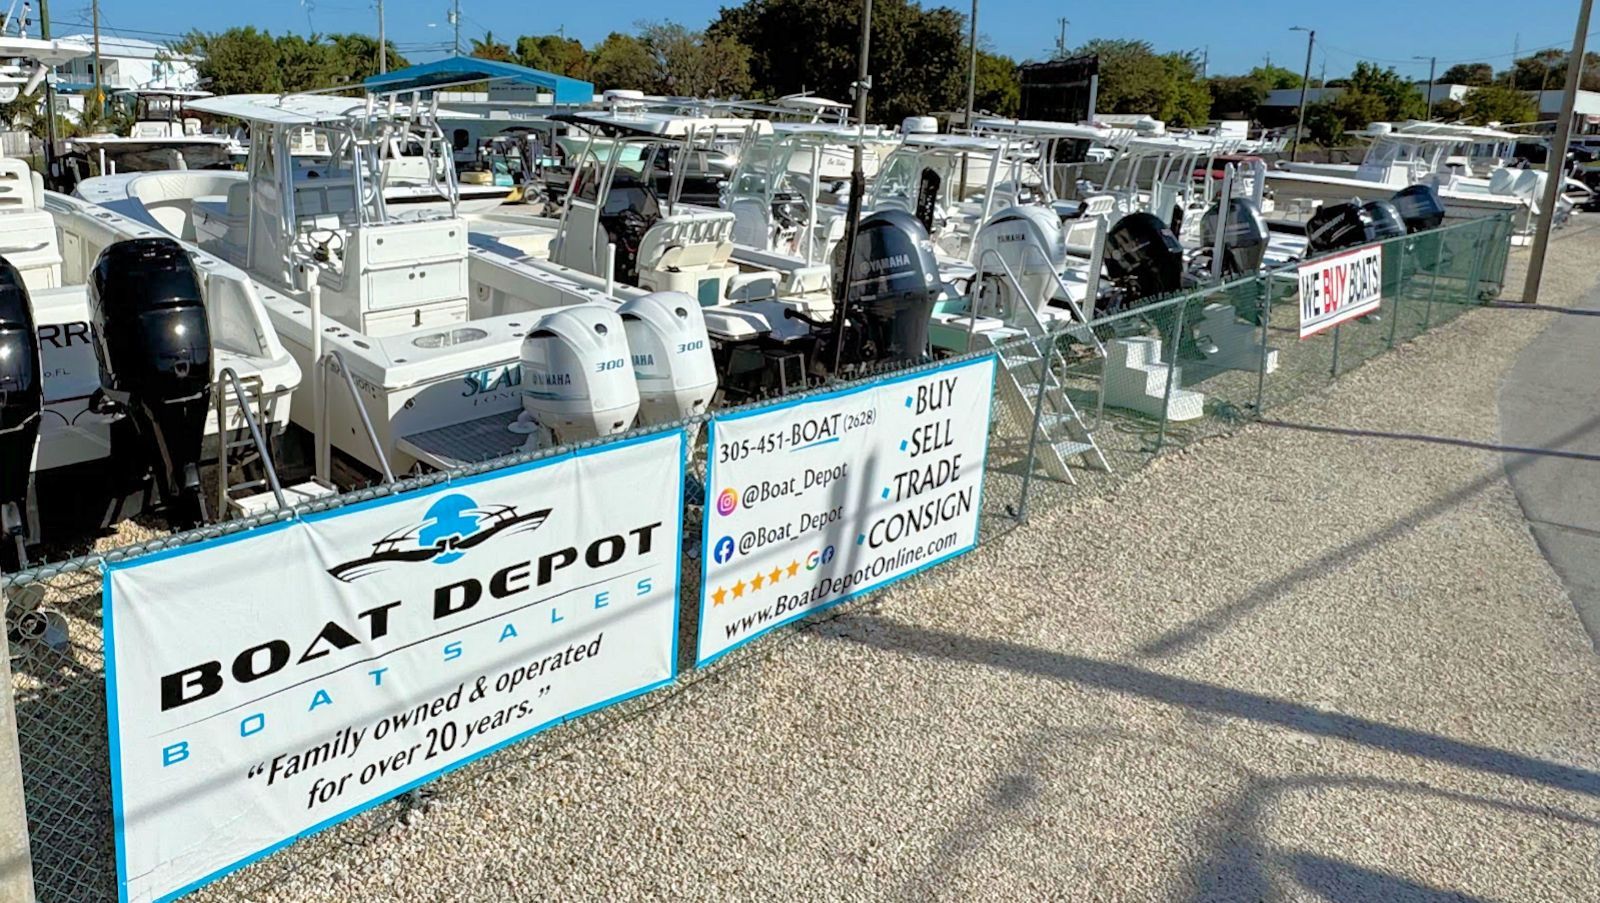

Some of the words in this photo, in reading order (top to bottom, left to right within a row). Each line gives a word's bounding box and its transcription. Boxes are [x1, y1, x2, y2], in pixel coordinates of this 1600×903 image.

[870, 254, 910, 272] YAMAHA
[1302, 272, 1320, 319] WE
[1323, 265, 1347, 313] BUY
[1349, 255, 1377, 303] BOATS
[595, 359, 624, 372] 300
[677, 340, 703, 354] 300
[916, 377, 957, 416] BUY
[720, 413, 842, 463] 305-451-BOAT
[843, 408, 877, 434] (2628)
[910, 419, 954, 458] SELL
[741, 462, 848, 511] @Boat_Depot
[894, 454, 963, 503] TRADE
[738, 504, 845, 555] @Boat_Depot
[868, 486, 974, 549] CONSIGN
[724, 529, 958, 641] www.BoatDepotOnline.com
[161, 601, 400, 711] BOAT
[433, 522, 662, 620] DEPOT
[373, 687, 463, 737] owned
[470, 679, 489, 703] &
[493, 633, 603, 694] operated
[306, 773, 353, 810] for
[359, 747, 420, 784] over
[423, 720, 460, 760] 20
